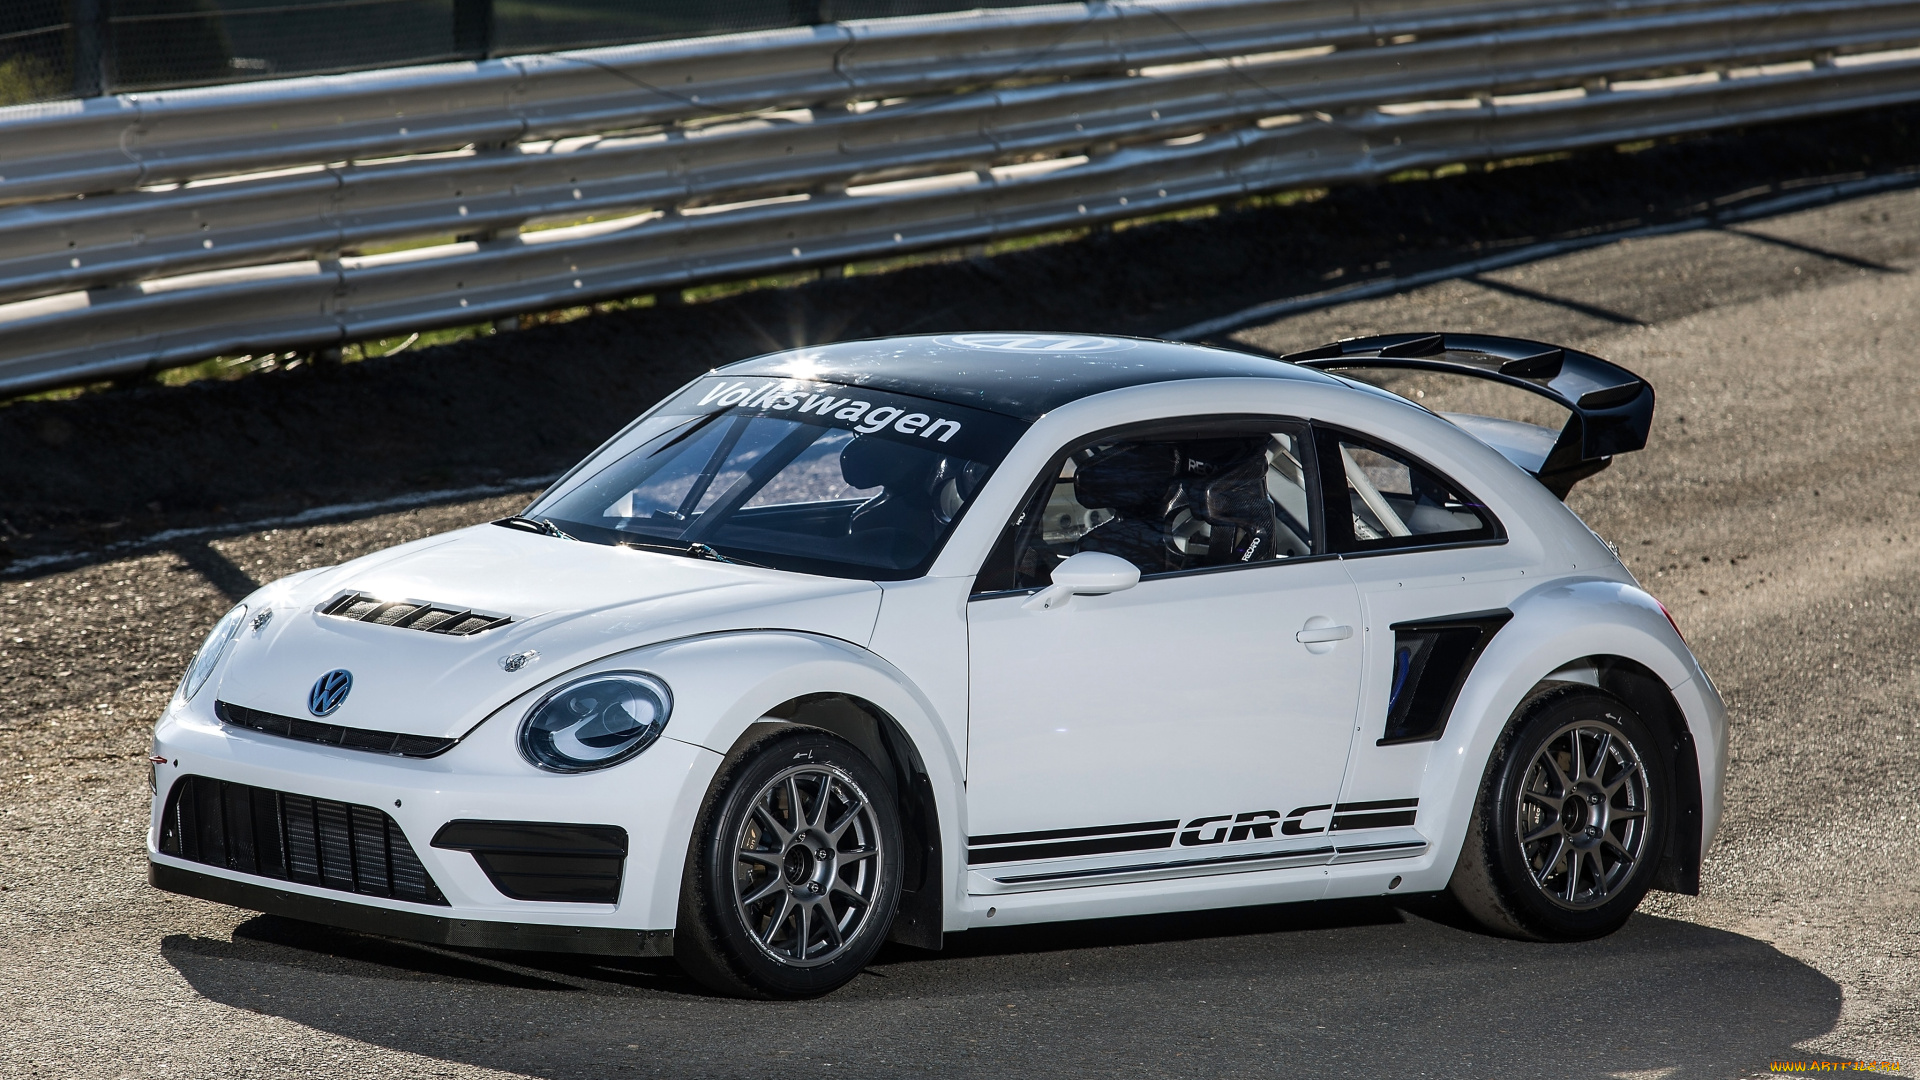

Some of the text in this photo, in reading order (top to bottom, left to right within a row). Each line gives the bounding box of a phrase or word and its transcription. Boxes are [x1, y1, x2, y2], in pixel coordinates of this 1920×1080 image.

[697, 381, 962, 443] Volkswagen
[1241, 537, 1261, 562] RECARO
[1179, 803, 1333, 846] GRC
